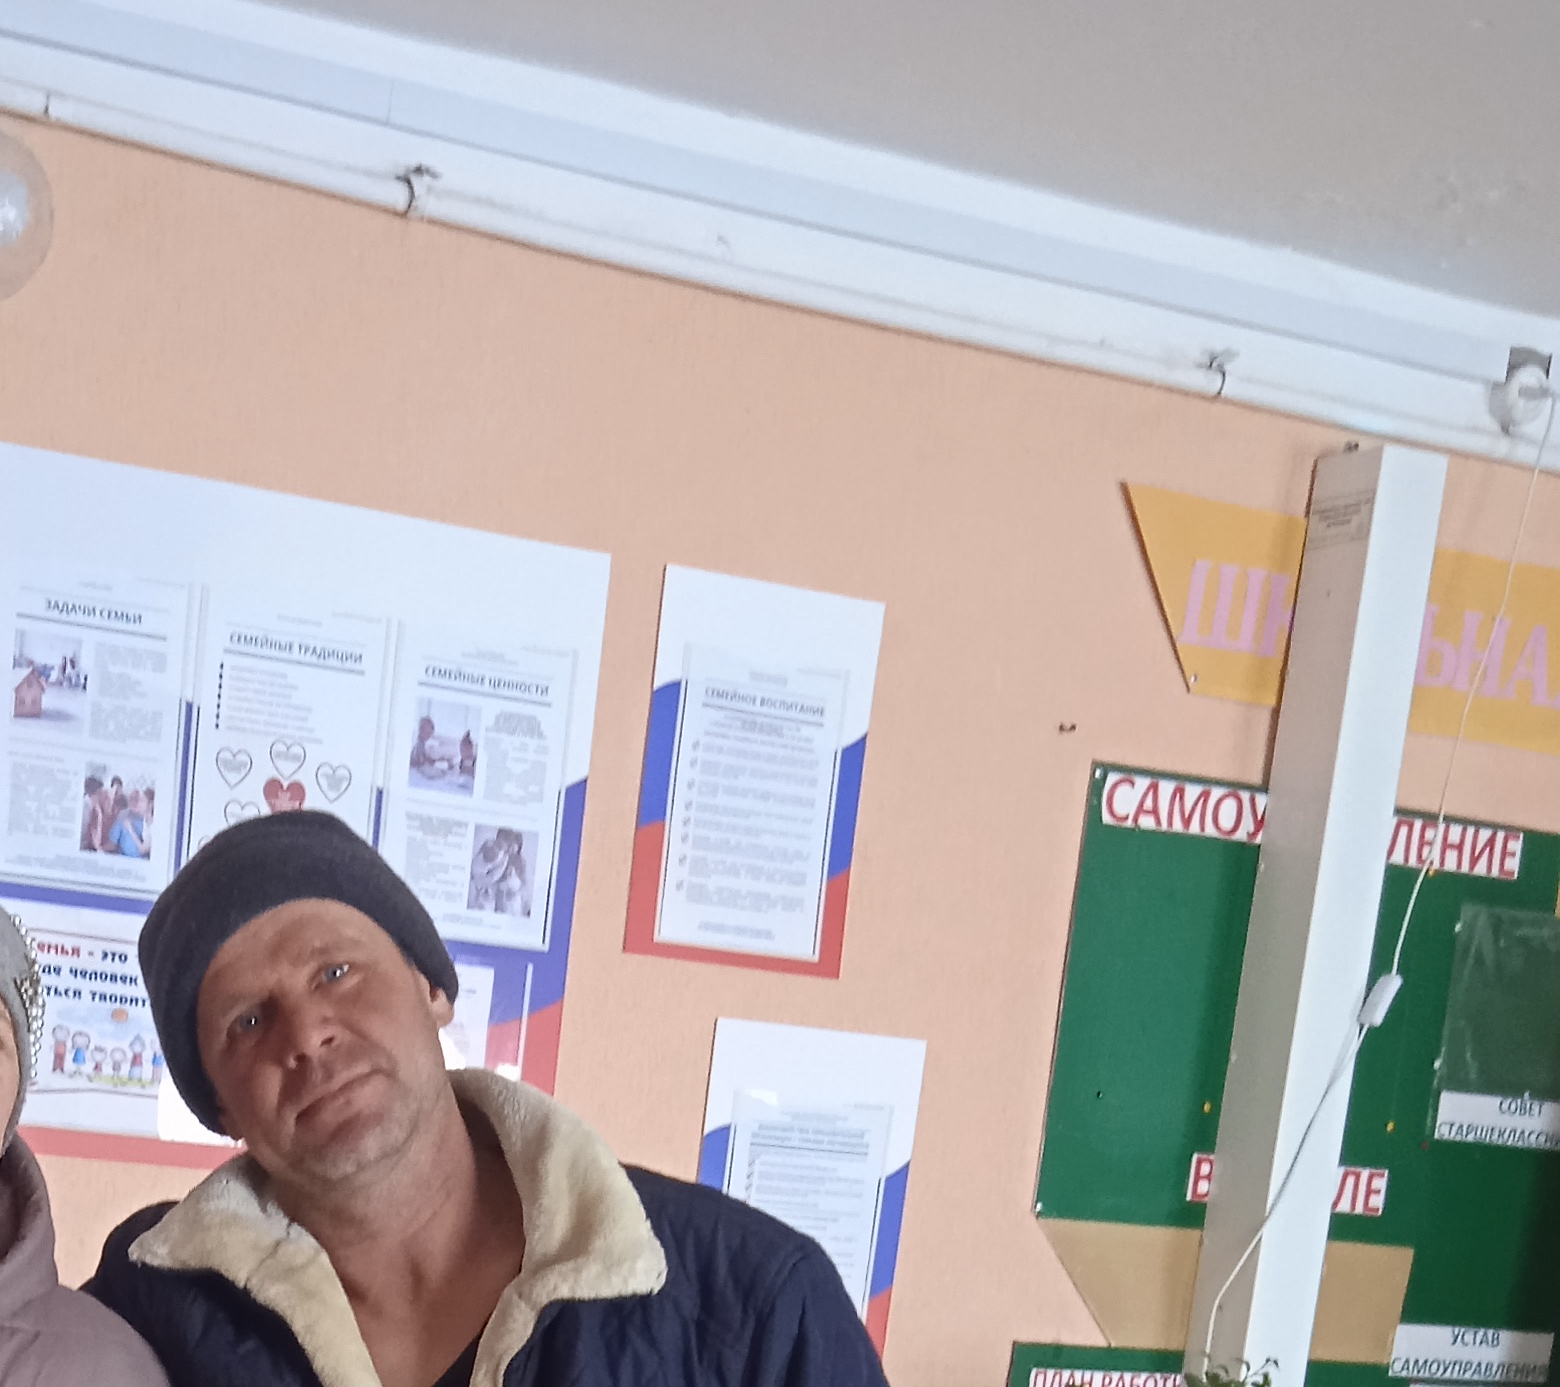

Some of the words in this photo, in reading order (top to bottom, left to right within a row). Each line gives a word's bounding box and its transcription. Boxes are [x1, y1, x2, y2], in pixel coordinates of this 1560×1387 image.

[45, 598, 97, 618] ЗАДАЧИ
[100, 607, 143, 626] СЕМЬИ
[230, 632, 294, 655] СЕМЕЙНЫЕ
[298, 643, 363, 665] ТРАДИЦИИ
[425, 665, 486, 685] СЕМЕЙНЫЕ
[488, 677, 550, 697] ЦЕННОСТИ
[705, 686, 757, 707] СЕМЕЙНОЕ
[760, 697, 825, 718] ВОСПИТАНИЕ
[1499, 1099, 1544, 1117] СОВЕТ
[1451, 1328, 1500, 1348] УСТАВ
